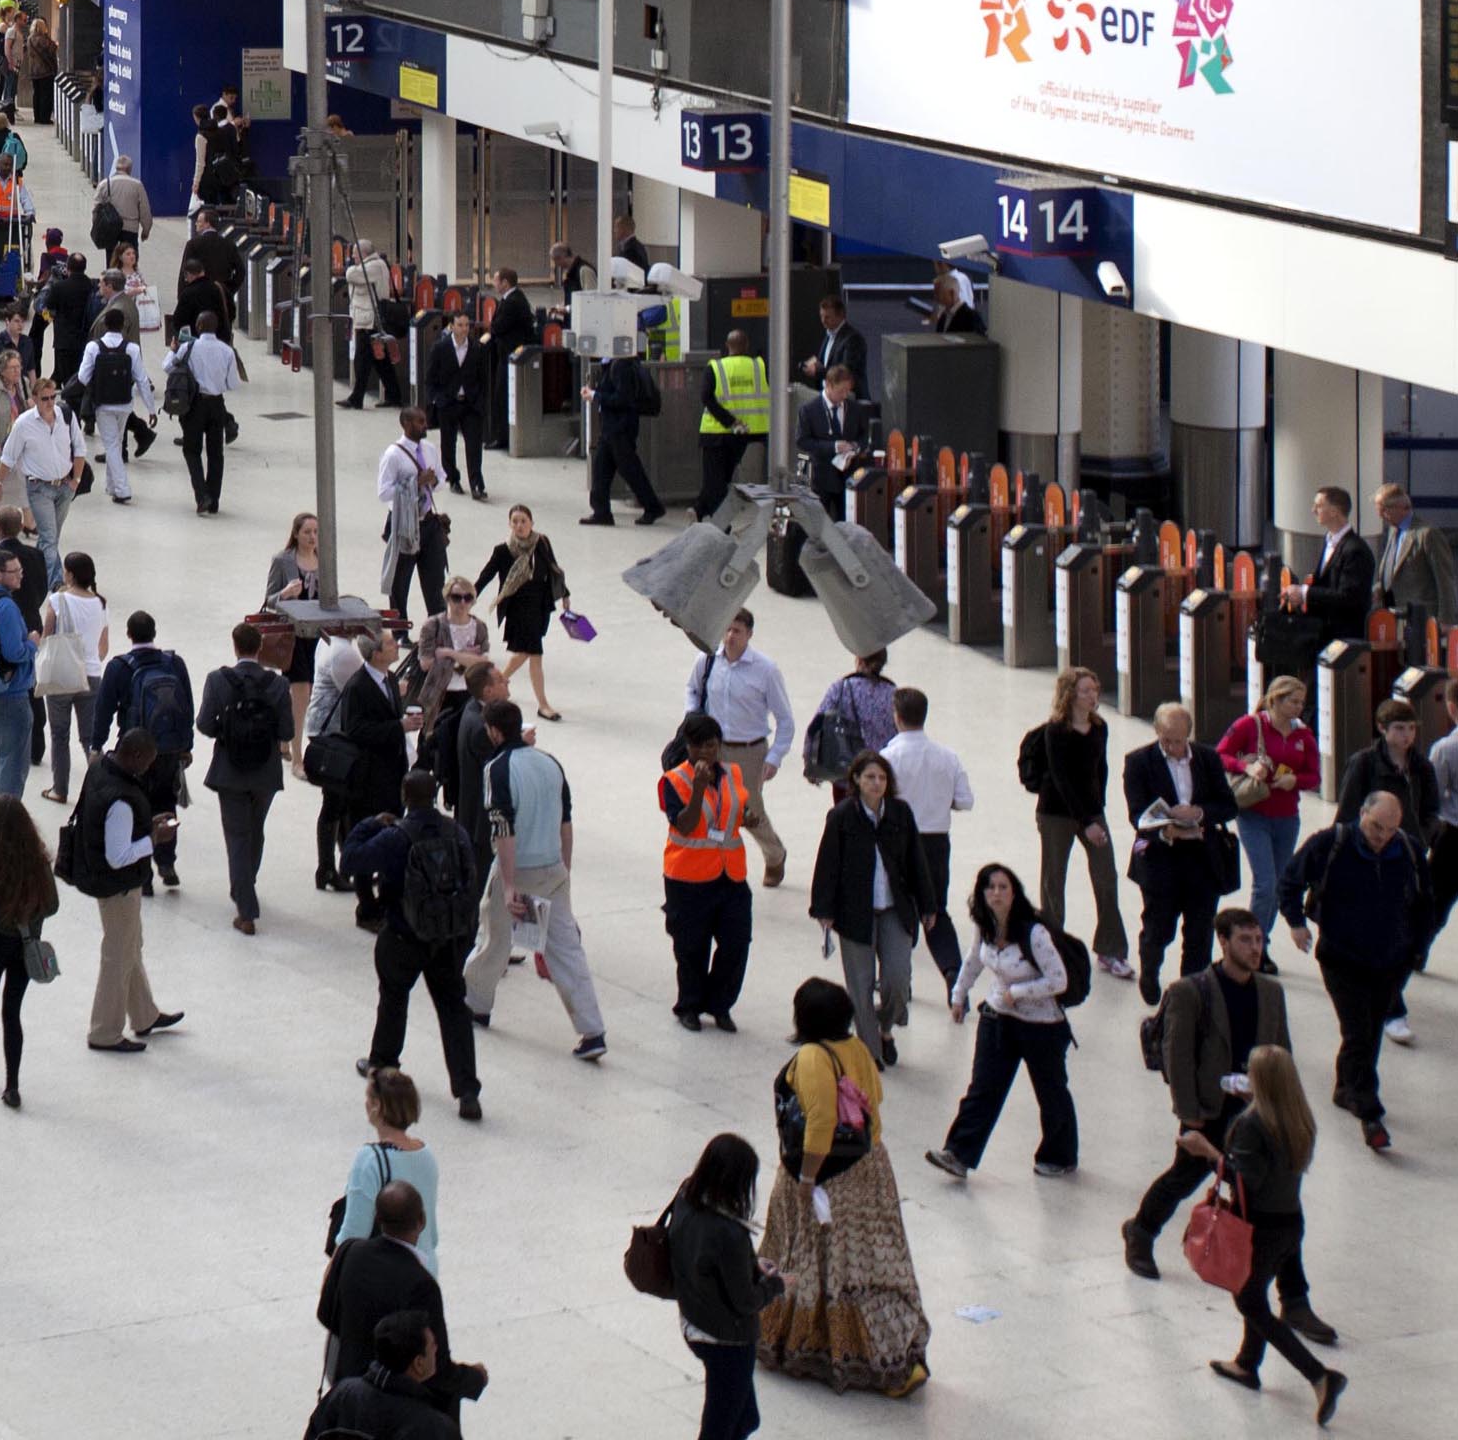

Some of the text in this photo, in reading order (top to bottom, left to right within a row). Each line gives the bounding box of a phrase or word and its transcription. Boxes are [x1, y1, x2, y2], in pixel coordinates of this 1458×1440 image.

[331, 23, 365, 53] 12
[1010, 95, 1196, 141] of the Olympic and Paralympic Games
[1038, 81, 1162, 115] official electricity supplier
[683, 120, 701, 160] 13
[710, 122, 754, 161] 13
[997, 194, 1028, 244] 14
[1037, 199, 1089, 244] 14
